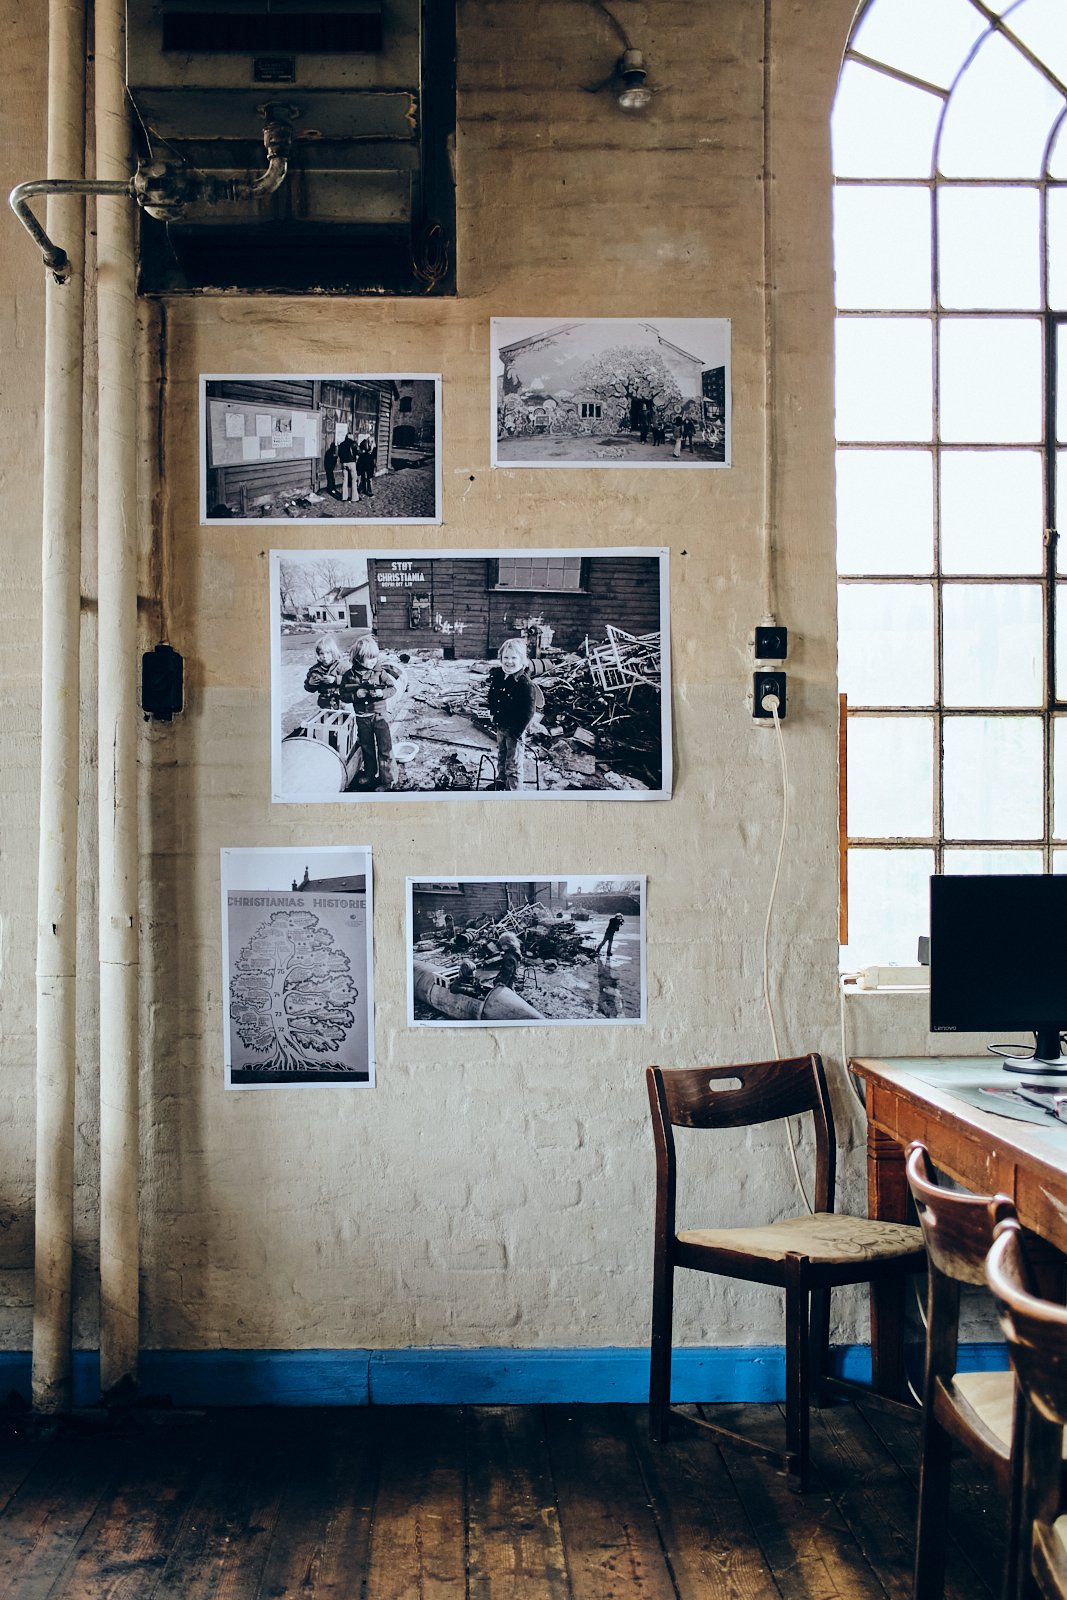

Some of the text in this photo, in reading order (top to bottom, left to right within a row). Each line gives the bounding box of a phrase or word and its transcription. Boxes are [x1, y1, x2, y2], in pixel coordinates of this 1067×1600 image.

[392, 562, 412, 570] STØT
[378, 572, 424, 582] CHRISTIANIA
[228, 896, 366, 909] CHRISTIANIAS HISTORIE
